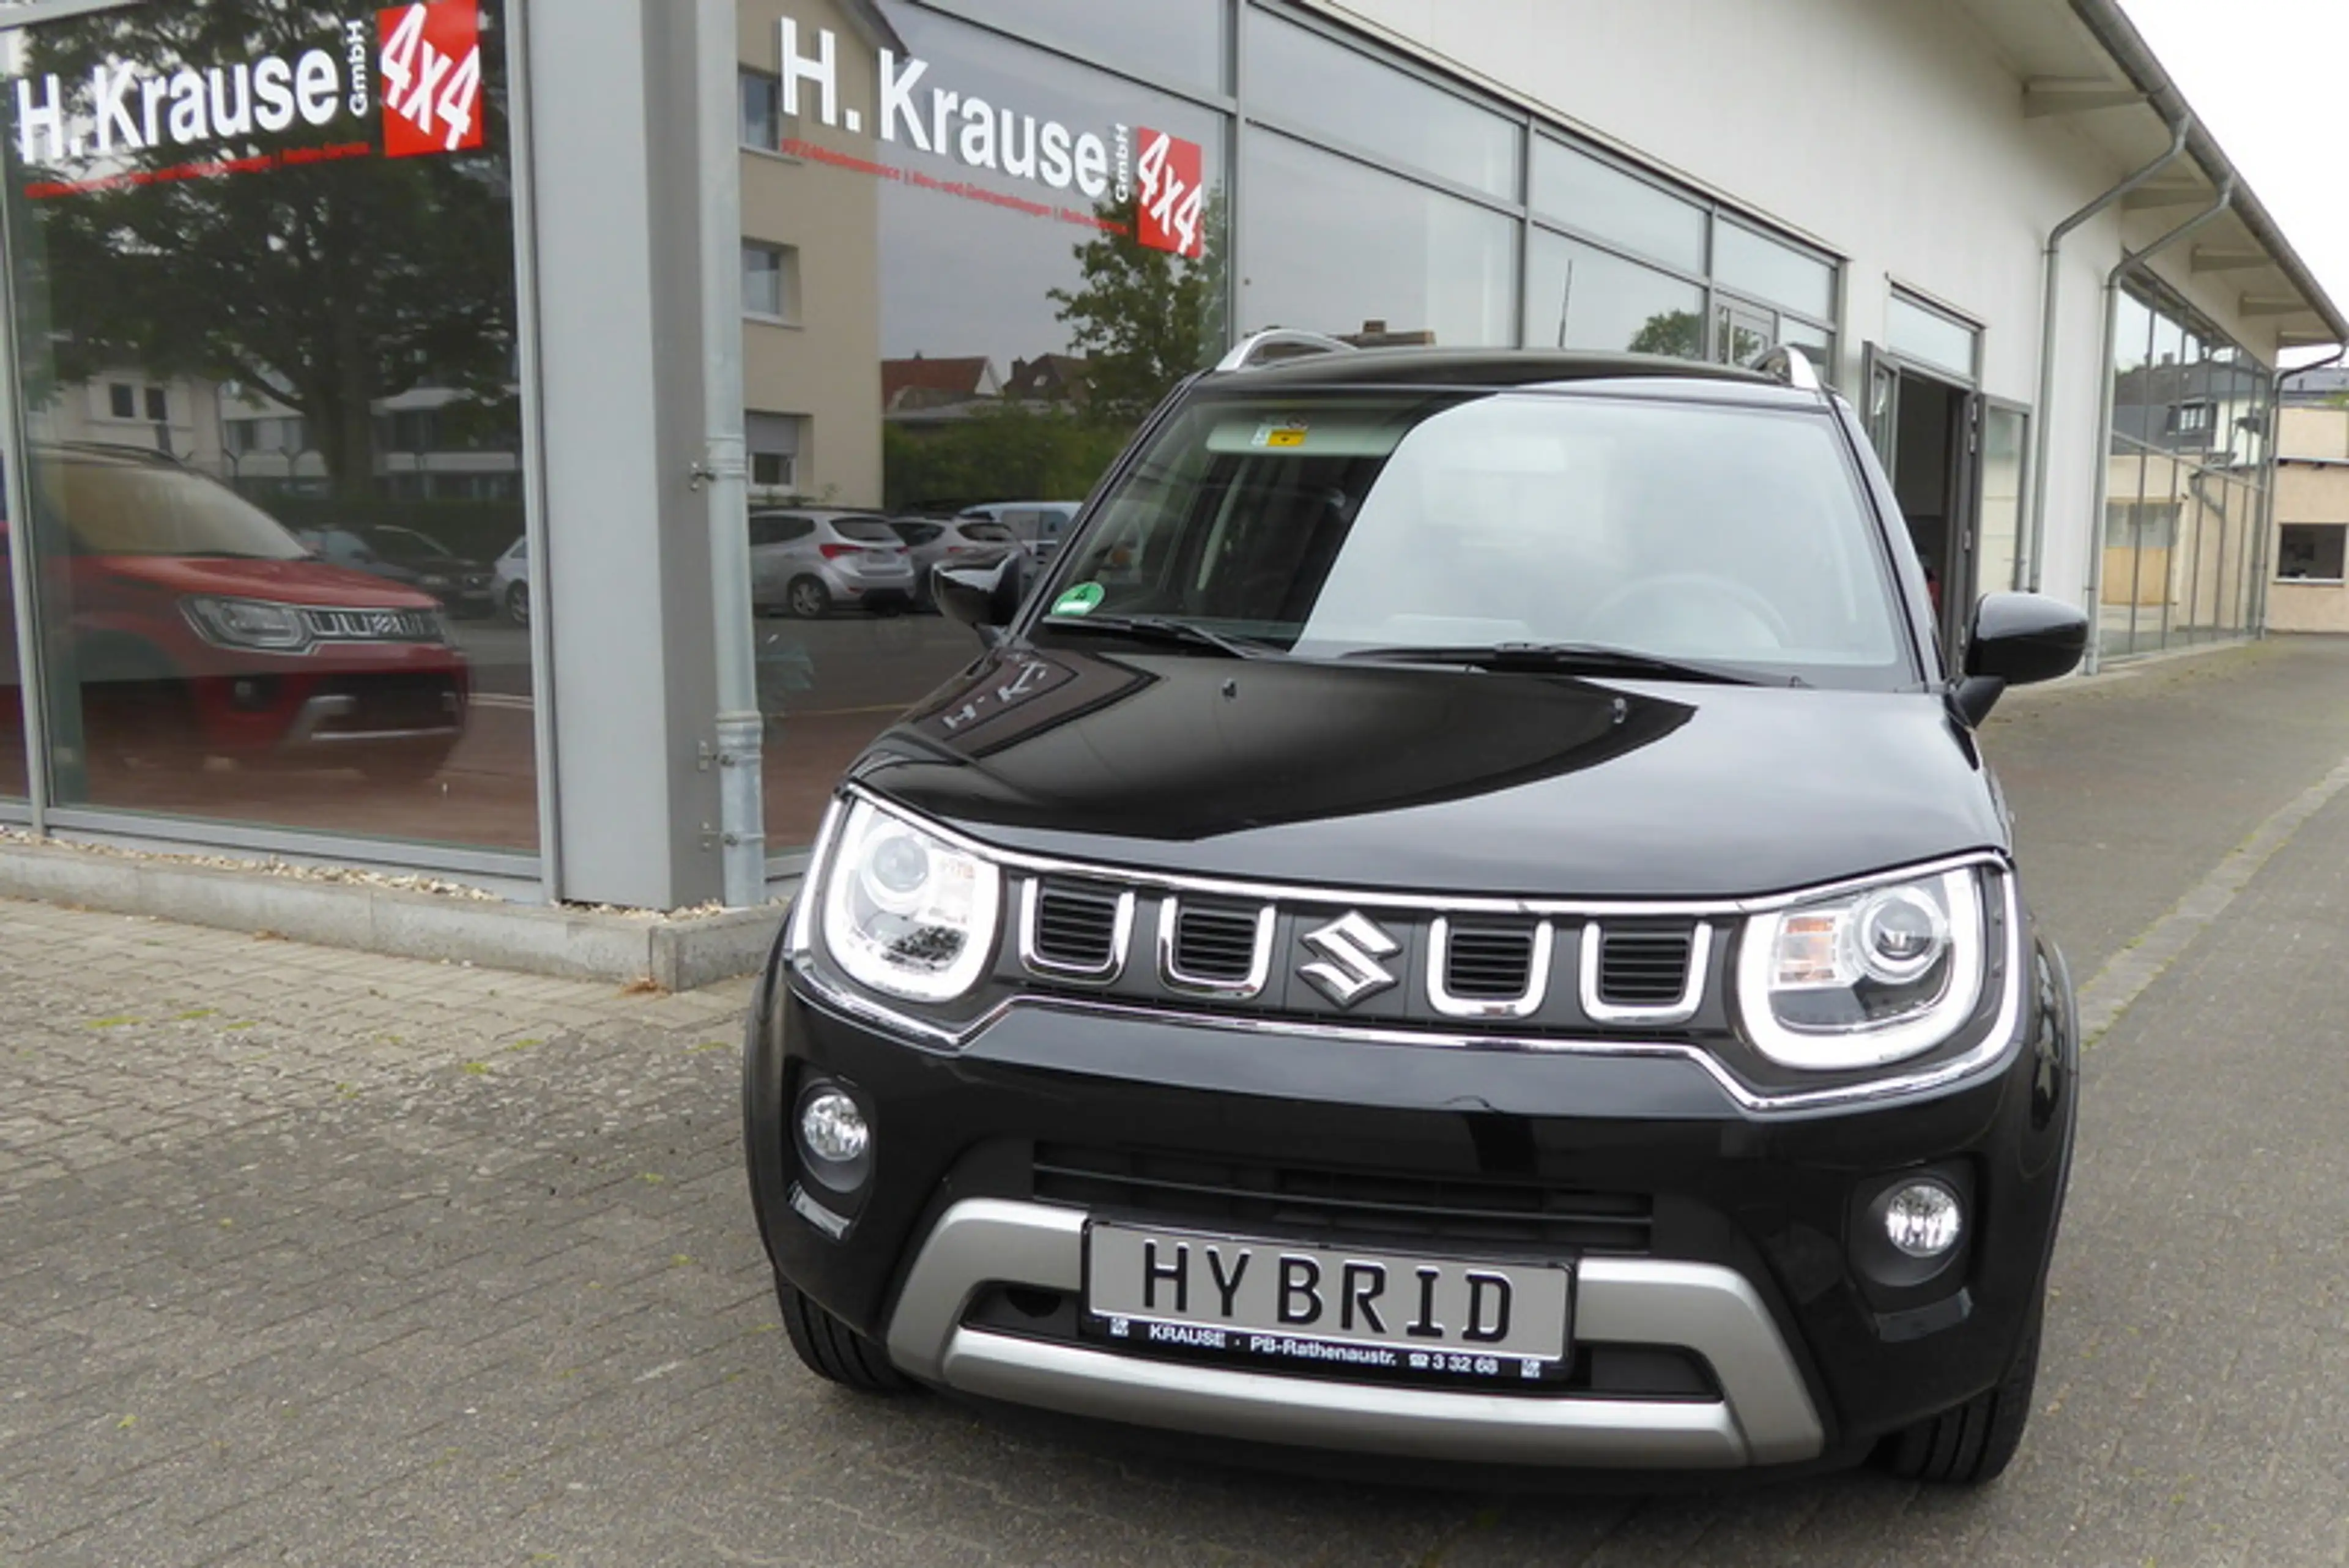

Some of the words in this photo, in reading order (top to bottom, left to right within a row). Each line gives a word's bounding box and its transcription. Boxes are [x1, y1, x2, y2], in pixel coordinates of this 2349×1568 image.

[346, 20, 368, 118] GmbH
[379, 2, 480, 151] 4x4
[880, 47, 1108, 198] Krause
[1115, 122, 1129, 204] GmbH
[1138, 132, 1203, 255] 4x4
[1143, 1238, 1515, 1343] HYBRID
[1149, 1323, 1226, 1348] KRAUSE
[1250, 1335, 1397, 1366] PB-Rathenaustr.
[1431, 1353, 1445, 1370] 3
[1447, 1355, 1472, 1373] 32
